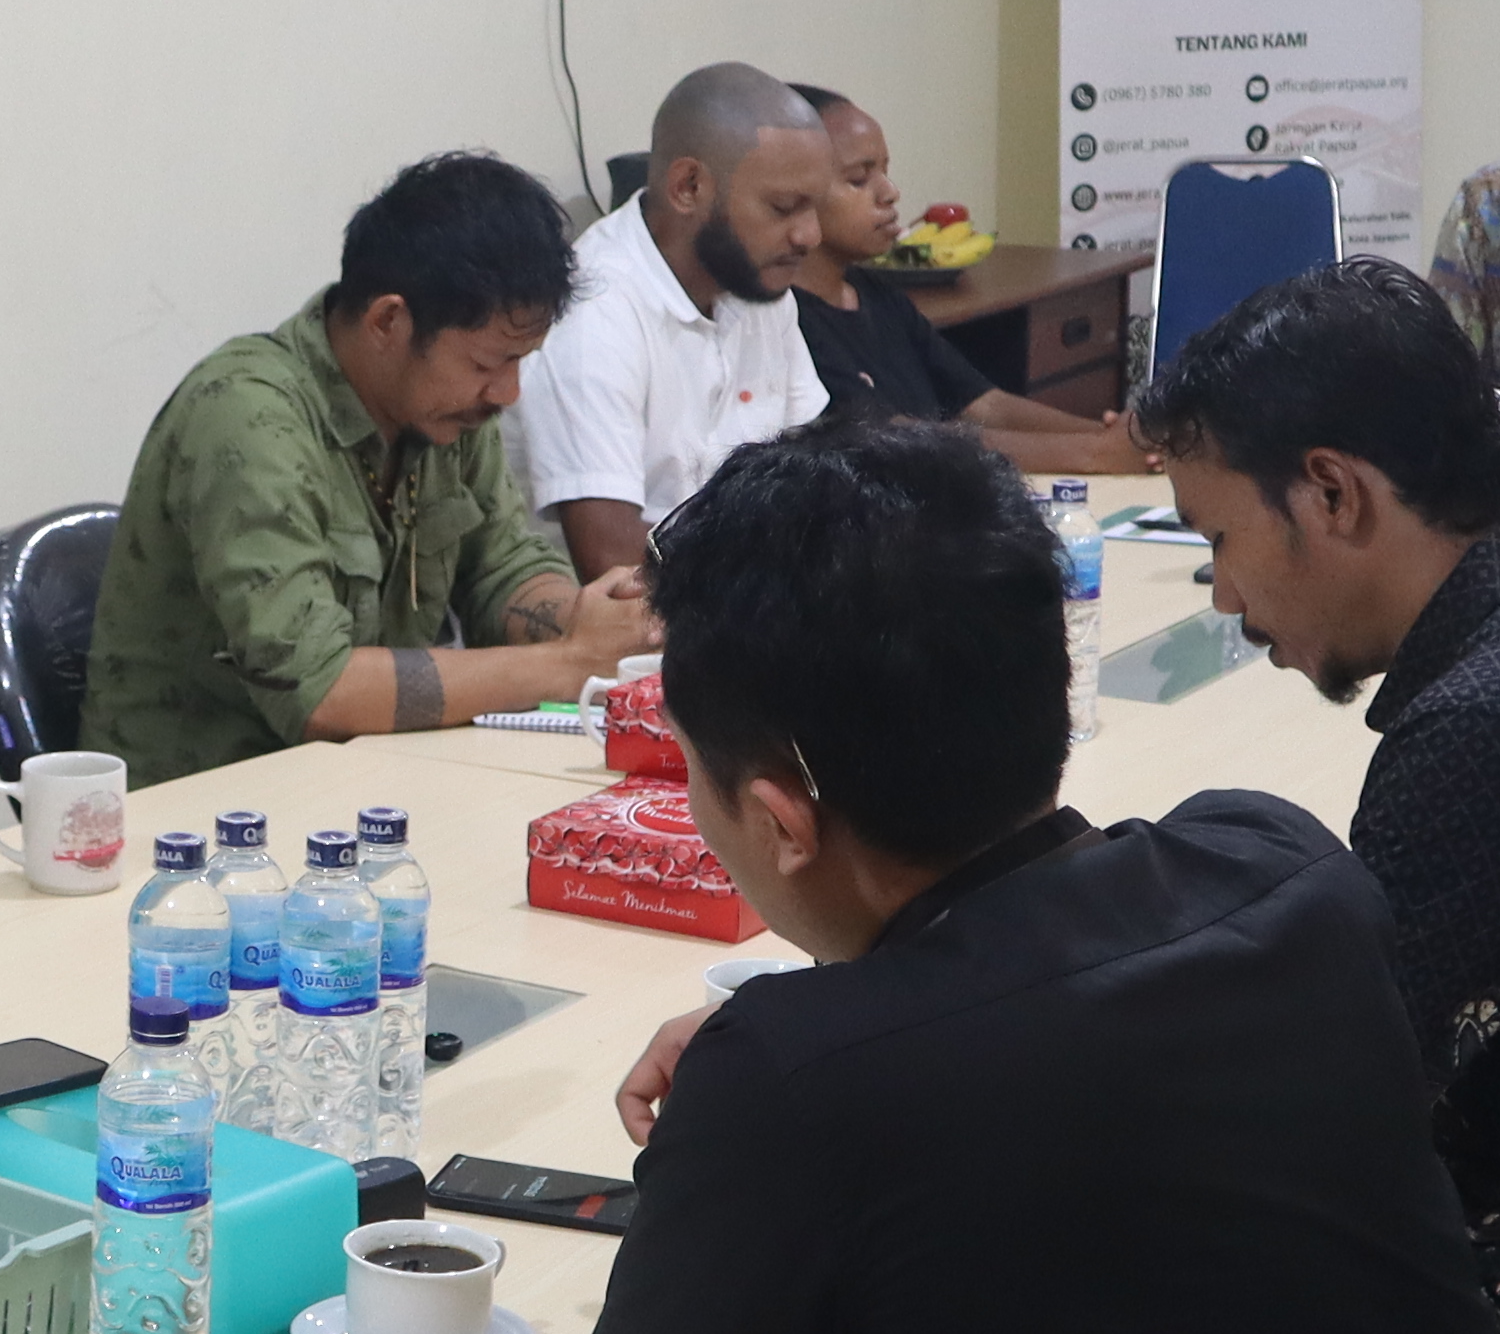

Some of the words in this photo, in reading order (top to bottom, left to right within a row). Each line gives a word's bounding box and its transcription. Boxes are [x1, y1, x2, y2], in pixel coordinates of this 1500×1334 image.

[1175, 34, 1259, 52] TENTANG
[1262, 32, 1308, 49] KAMI
[1103, 86, 1147, 103] (0967)
[1151, 84, 1184, 99] 5780
[1188, 83, 1212, 98] 380
[1275, 76, 1409, 94] office@jeratpapua.org
[1275, 122, 1326, 136] Jaringan
[1330, 120, 1363, 134] Kerja
[1103, 137, 1190, 155] @jerat_papua
[1275, 142, 1315, 156] Rakyat
[1319, 140, 1358, 154] Papua
[562, 880, 617, 906] Selamat
[621, 890, 698, 921] Menikmati
[110, 1155, 182, 1181] QUALALA
